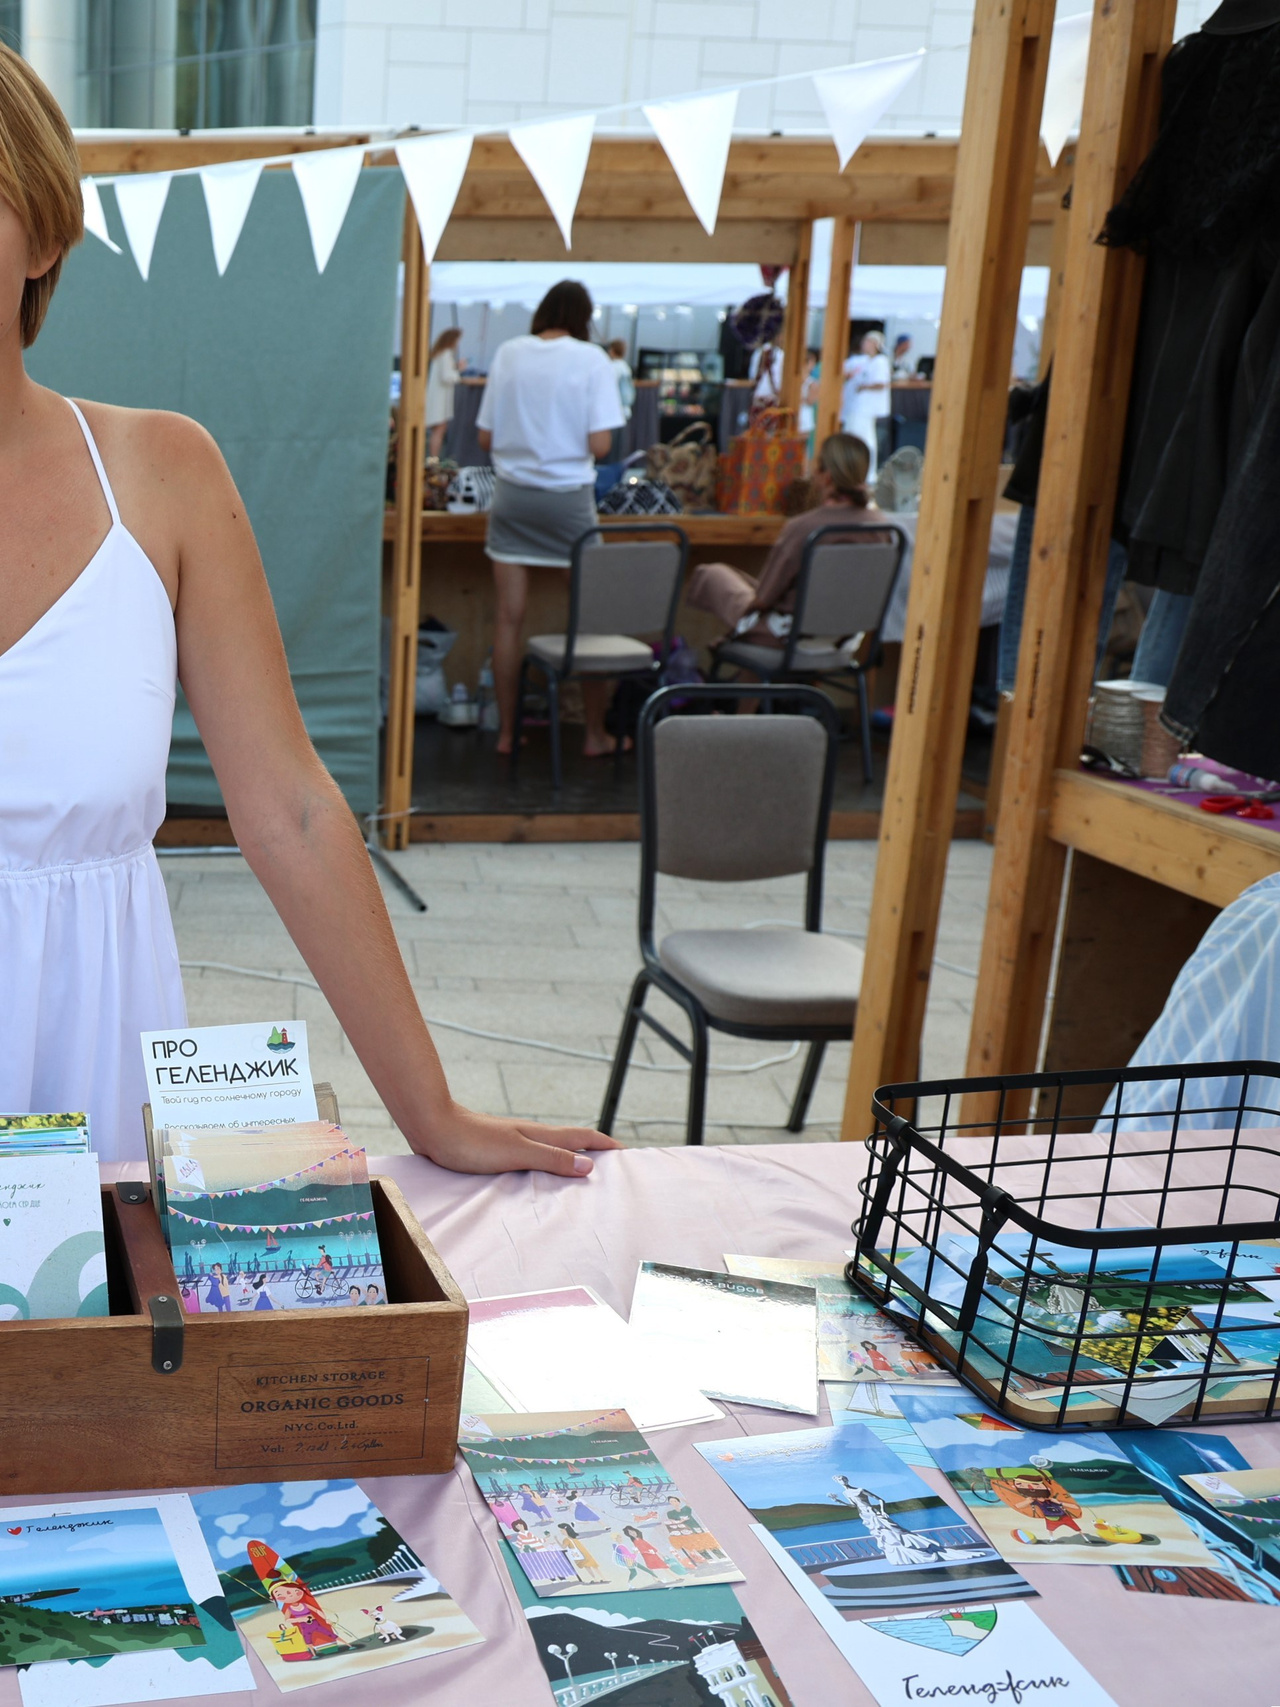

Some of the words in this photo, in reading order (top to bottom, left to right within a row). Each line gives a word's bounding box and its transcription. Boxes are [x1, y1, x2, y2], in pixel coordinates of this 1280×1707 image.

[151, 1038, 198, 1060] ПРО
[155, 1057, 299, 1085] ГЕЛЕНДЖИК
[161, 1095, 181, 1104] Твой
[183, 1096, 199, 1105] гид
[214, 1091, 268, 1102] солнечному
[270, 1088, 302, 1098] городу
[228, 1119, 240, 1129] об
[241, 1116, 296, 1128] интересных
[256, 1374, 319, 1386] KITCHEN
[322, 1371, 386, 1383] STORAGE
[240, 1398, 331, 1414] ORGANIC
[336, 1394, 404, 1409] GOODS
[901, 1670, 1070, 1704] Геленджик
